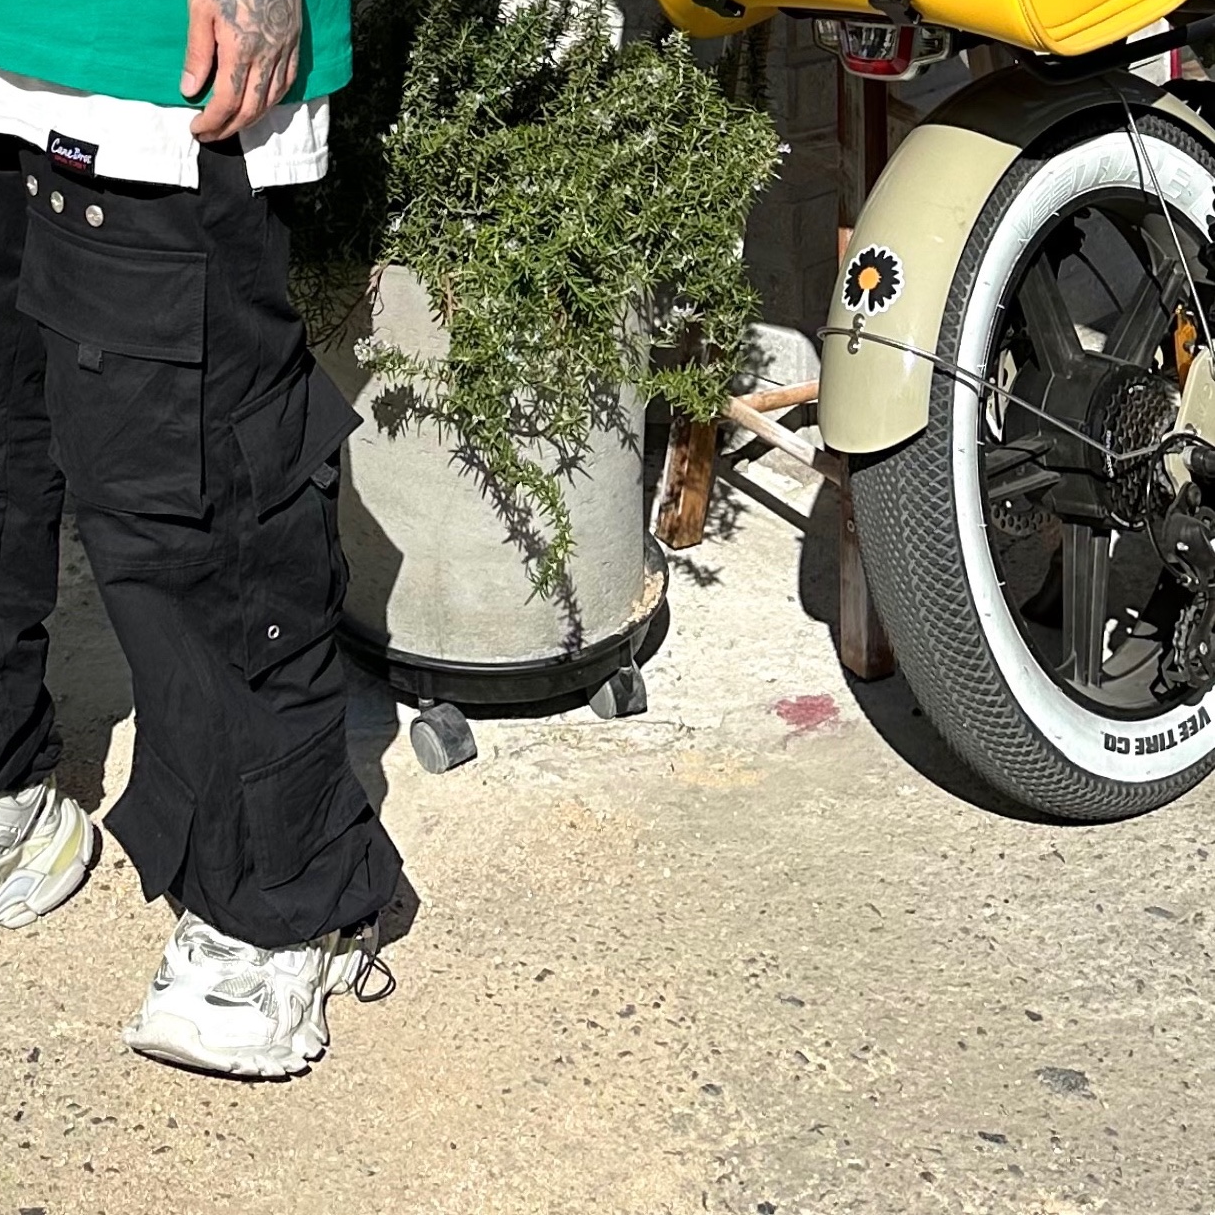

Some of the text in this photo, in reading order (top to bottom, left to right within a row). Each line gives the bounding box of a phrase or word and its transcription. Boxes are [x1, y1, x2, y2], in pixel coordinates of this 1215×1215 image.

[1103, 705, 1212, 756] VEE TIRE CO
